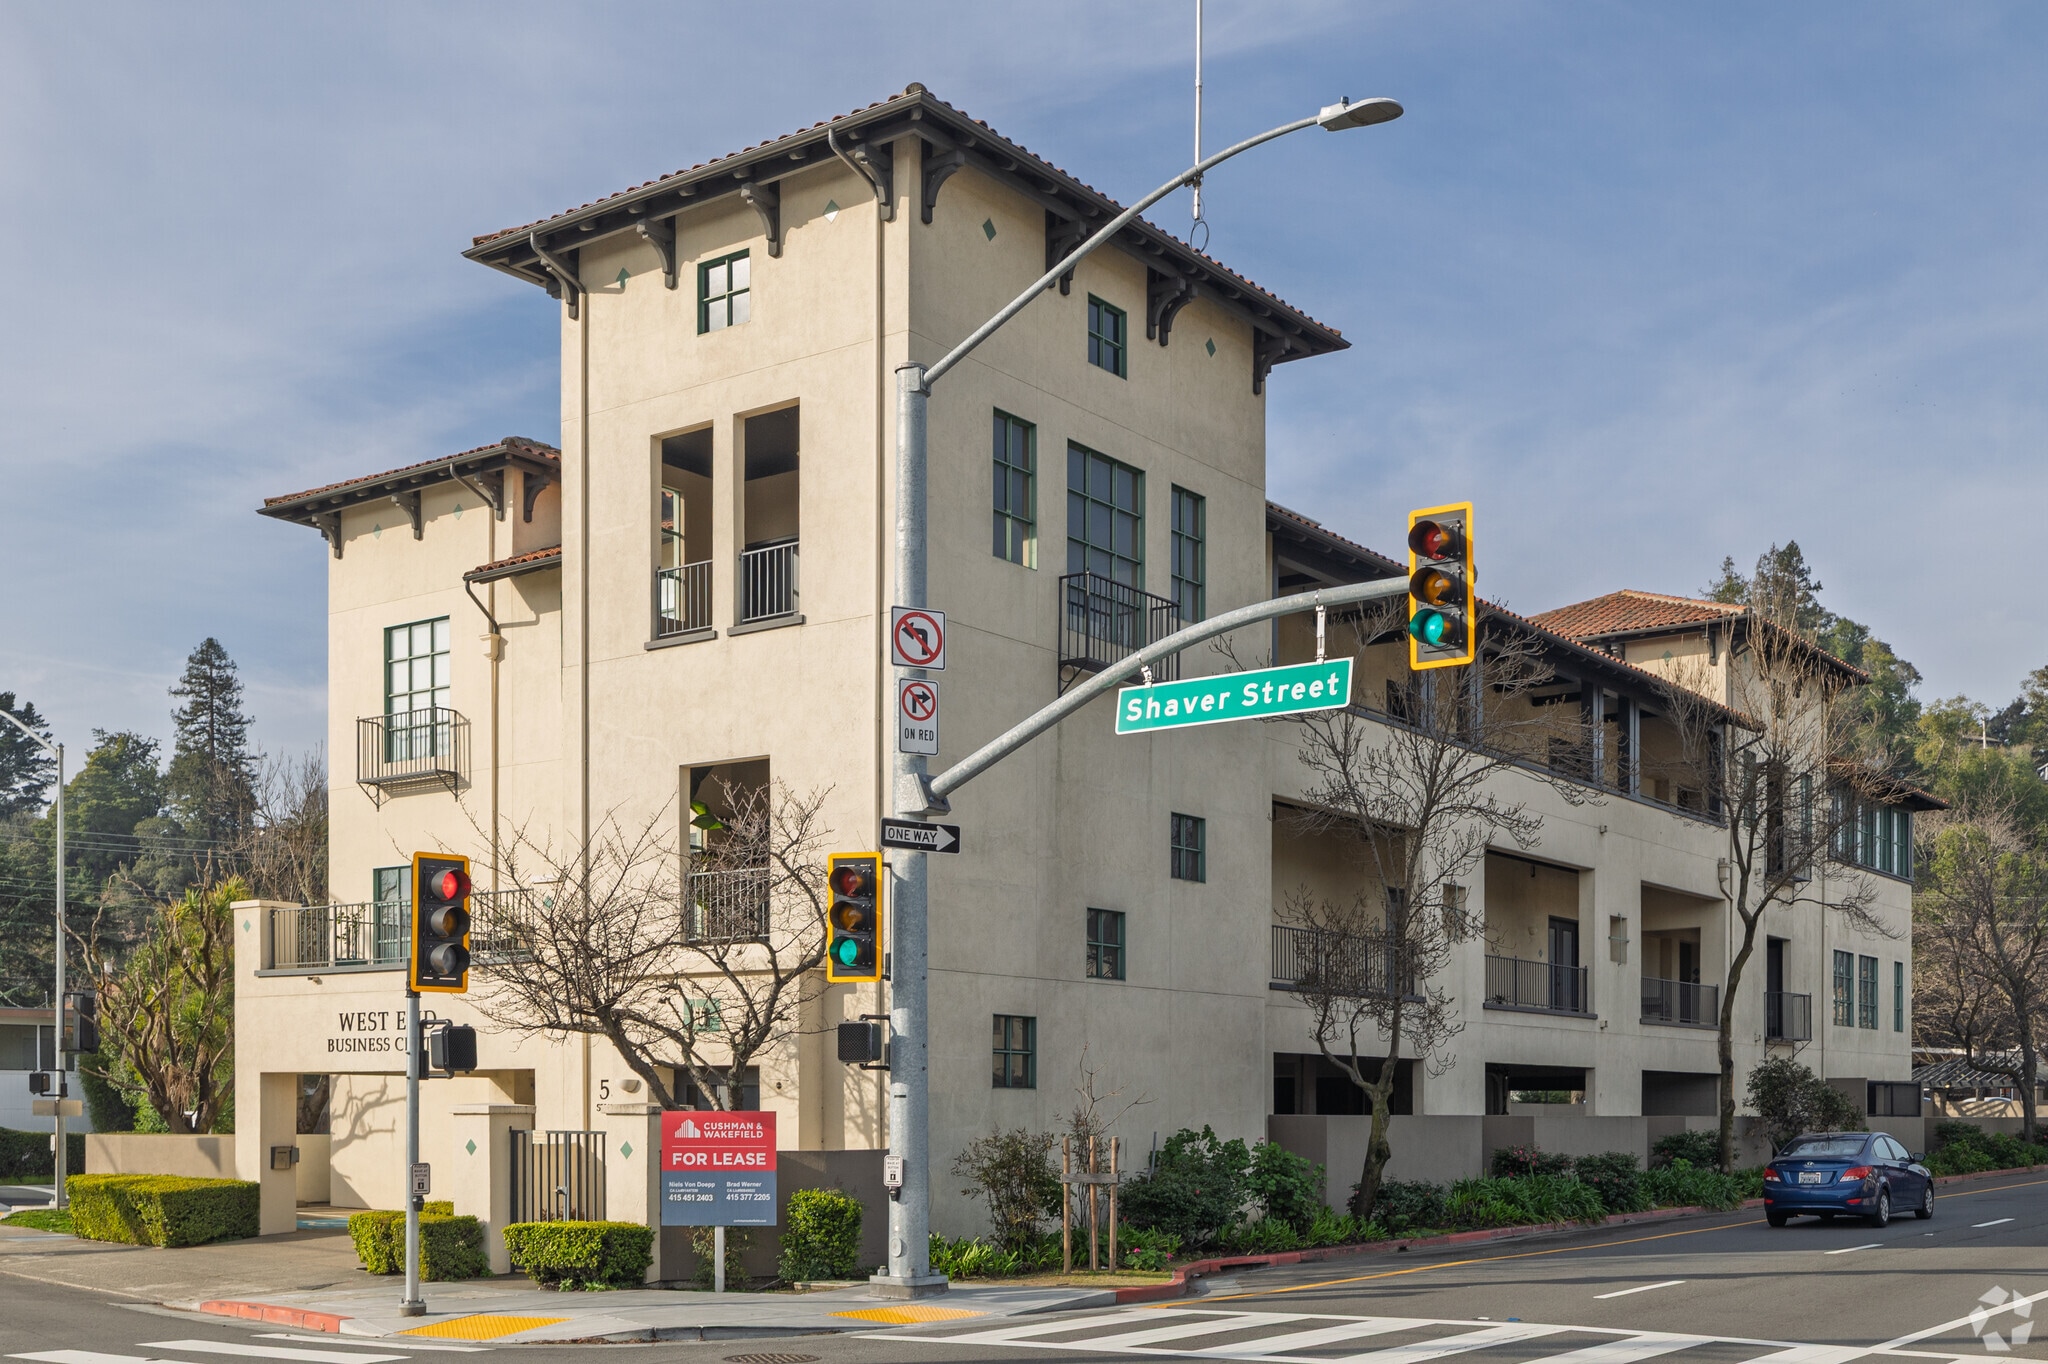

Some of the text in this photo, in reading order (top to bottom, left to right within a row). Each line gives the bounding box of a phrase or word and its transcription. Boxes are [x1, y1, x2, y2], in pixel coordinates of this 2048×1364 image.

[1125, 672, 1340, 721] Shaver Street
[904, 727, 934, 742] ON RED
[888, 827, 938, 843] ONE WAY
[339, 1010, 437, 1032] WEST ED
[327, 1037, 390, 1053] BUSINESS
[599, 1079, 610, 1100] 5
[703, 1122, 763, 1130] CUSHMAN &
[703, 1130, 764, 1138] WAKEFIELD
[672, 1152, 767, 1166] FOR LEASE
